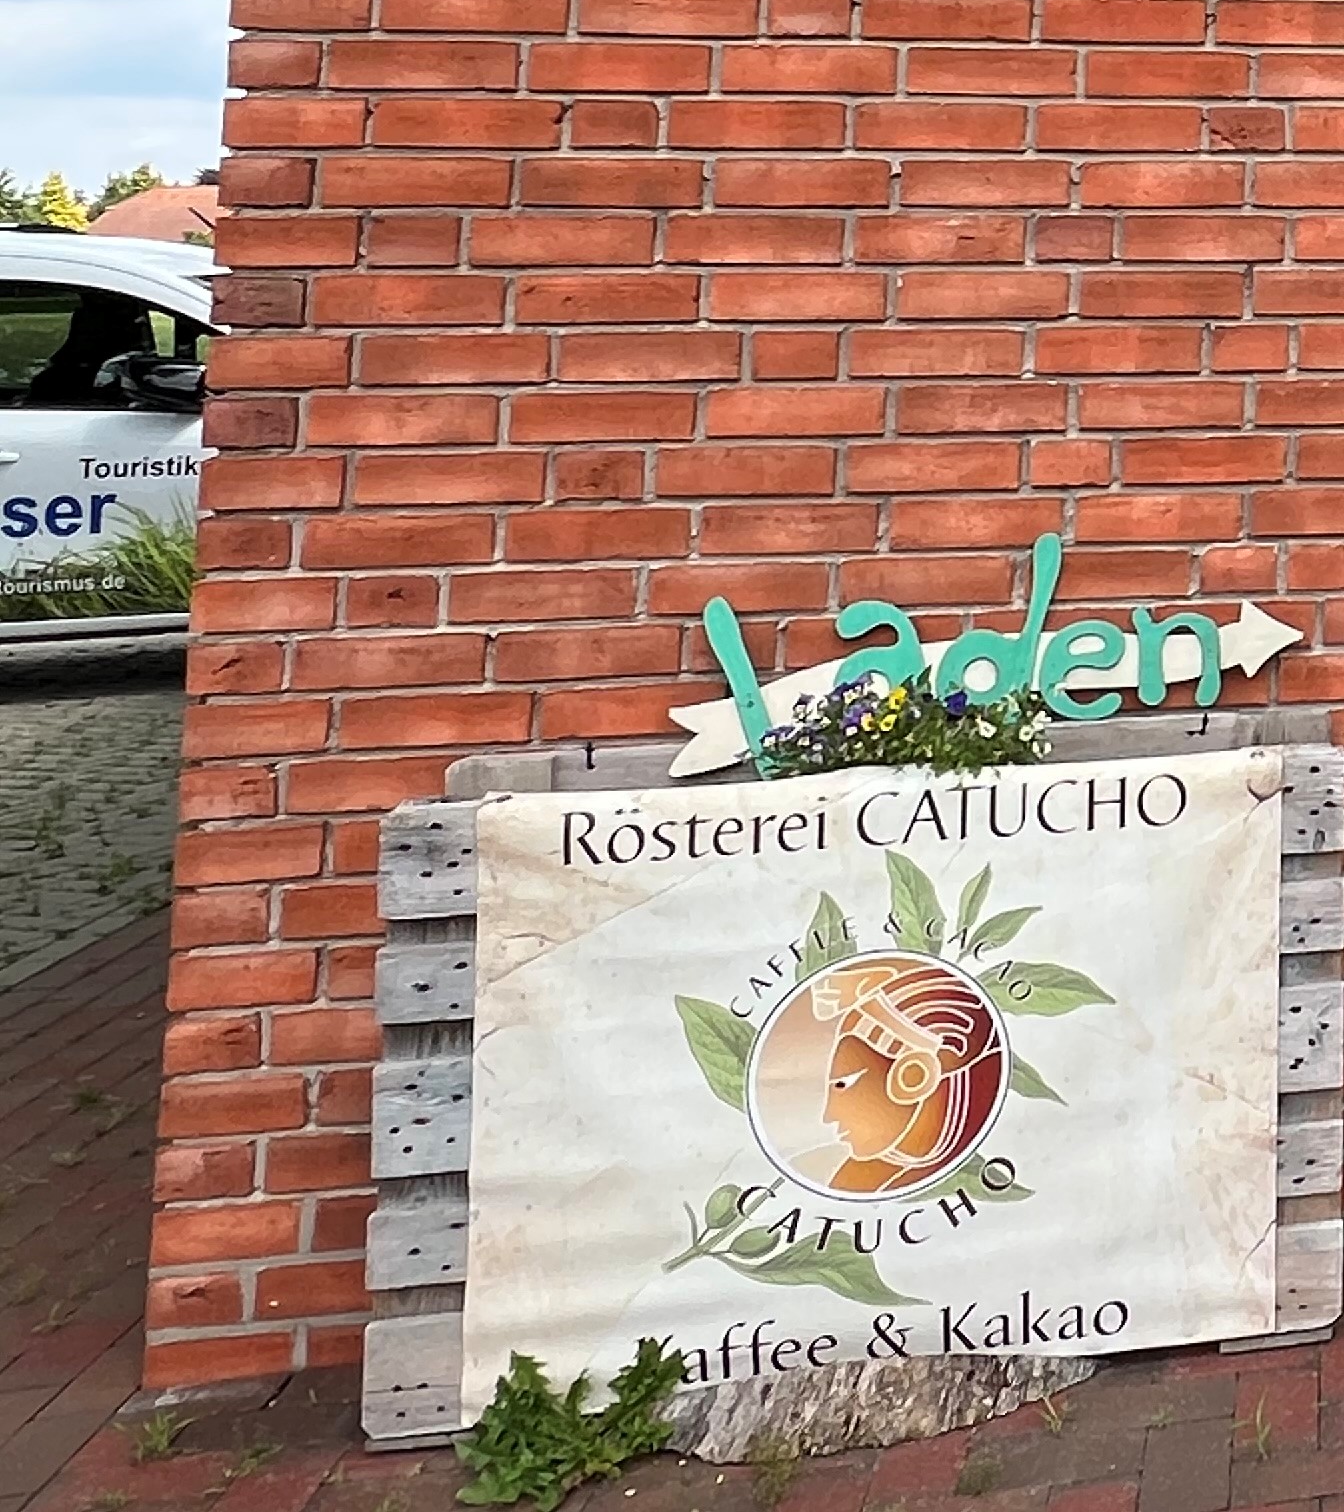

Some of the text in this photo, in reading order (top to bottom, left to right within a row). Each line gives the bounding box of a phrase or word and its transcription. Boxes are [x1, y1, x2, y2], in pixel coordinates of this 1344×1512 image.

[79, 455, 198, 479] Touristik
[562, 772, 1188, 868] Rösterei CATUCHO
[730, 912, 1032, 1018] CAFFEE & CACAO
[735, 1156, 1016, 1254] CATUCHO
[867, 1312, 913, 1358] &
[941, 1290, 1129, 1354] Kakao
